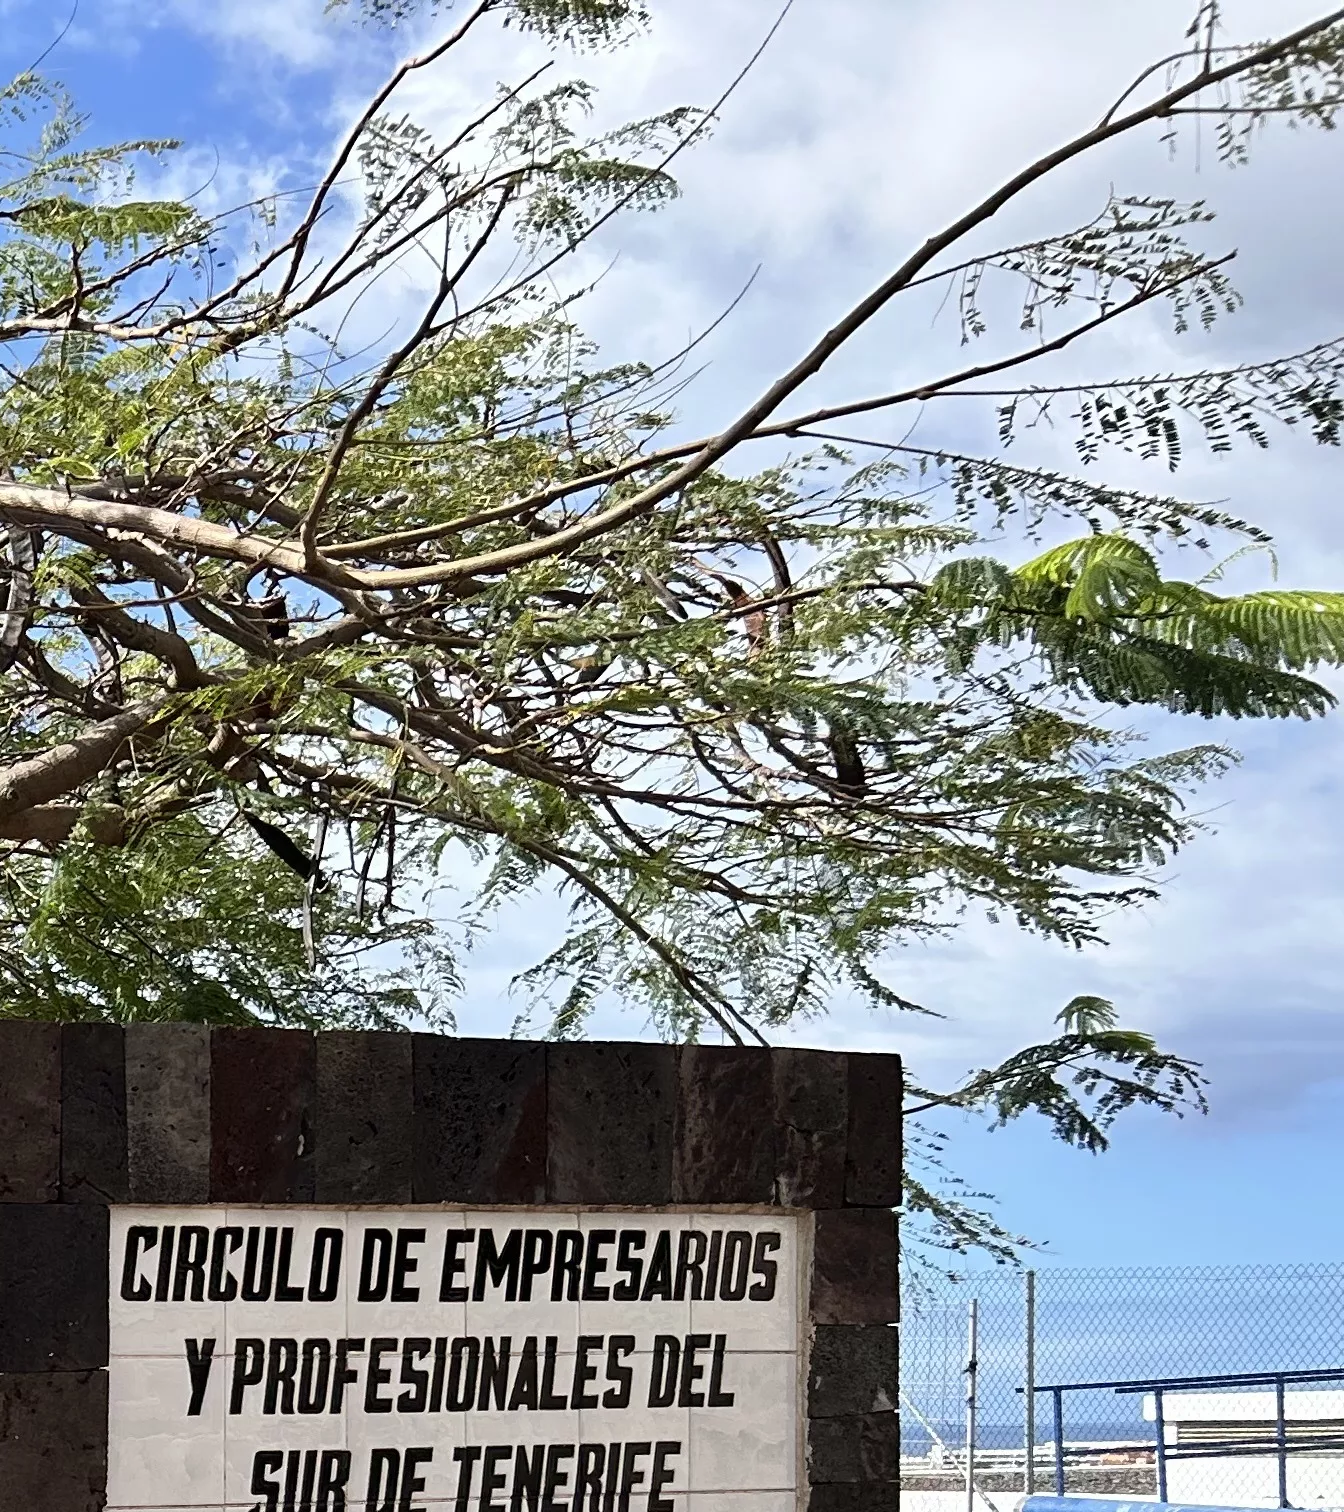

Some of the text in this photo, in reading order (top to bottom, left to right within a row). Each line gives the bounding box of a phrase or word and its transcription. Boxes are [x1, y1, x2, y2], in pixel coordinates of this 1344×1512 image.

[120, 1225, 781, 1303] CIRCULO DE EMPRESARIOS
[185, 1334, 735, 1416] Y PROFESIONALES DEL
